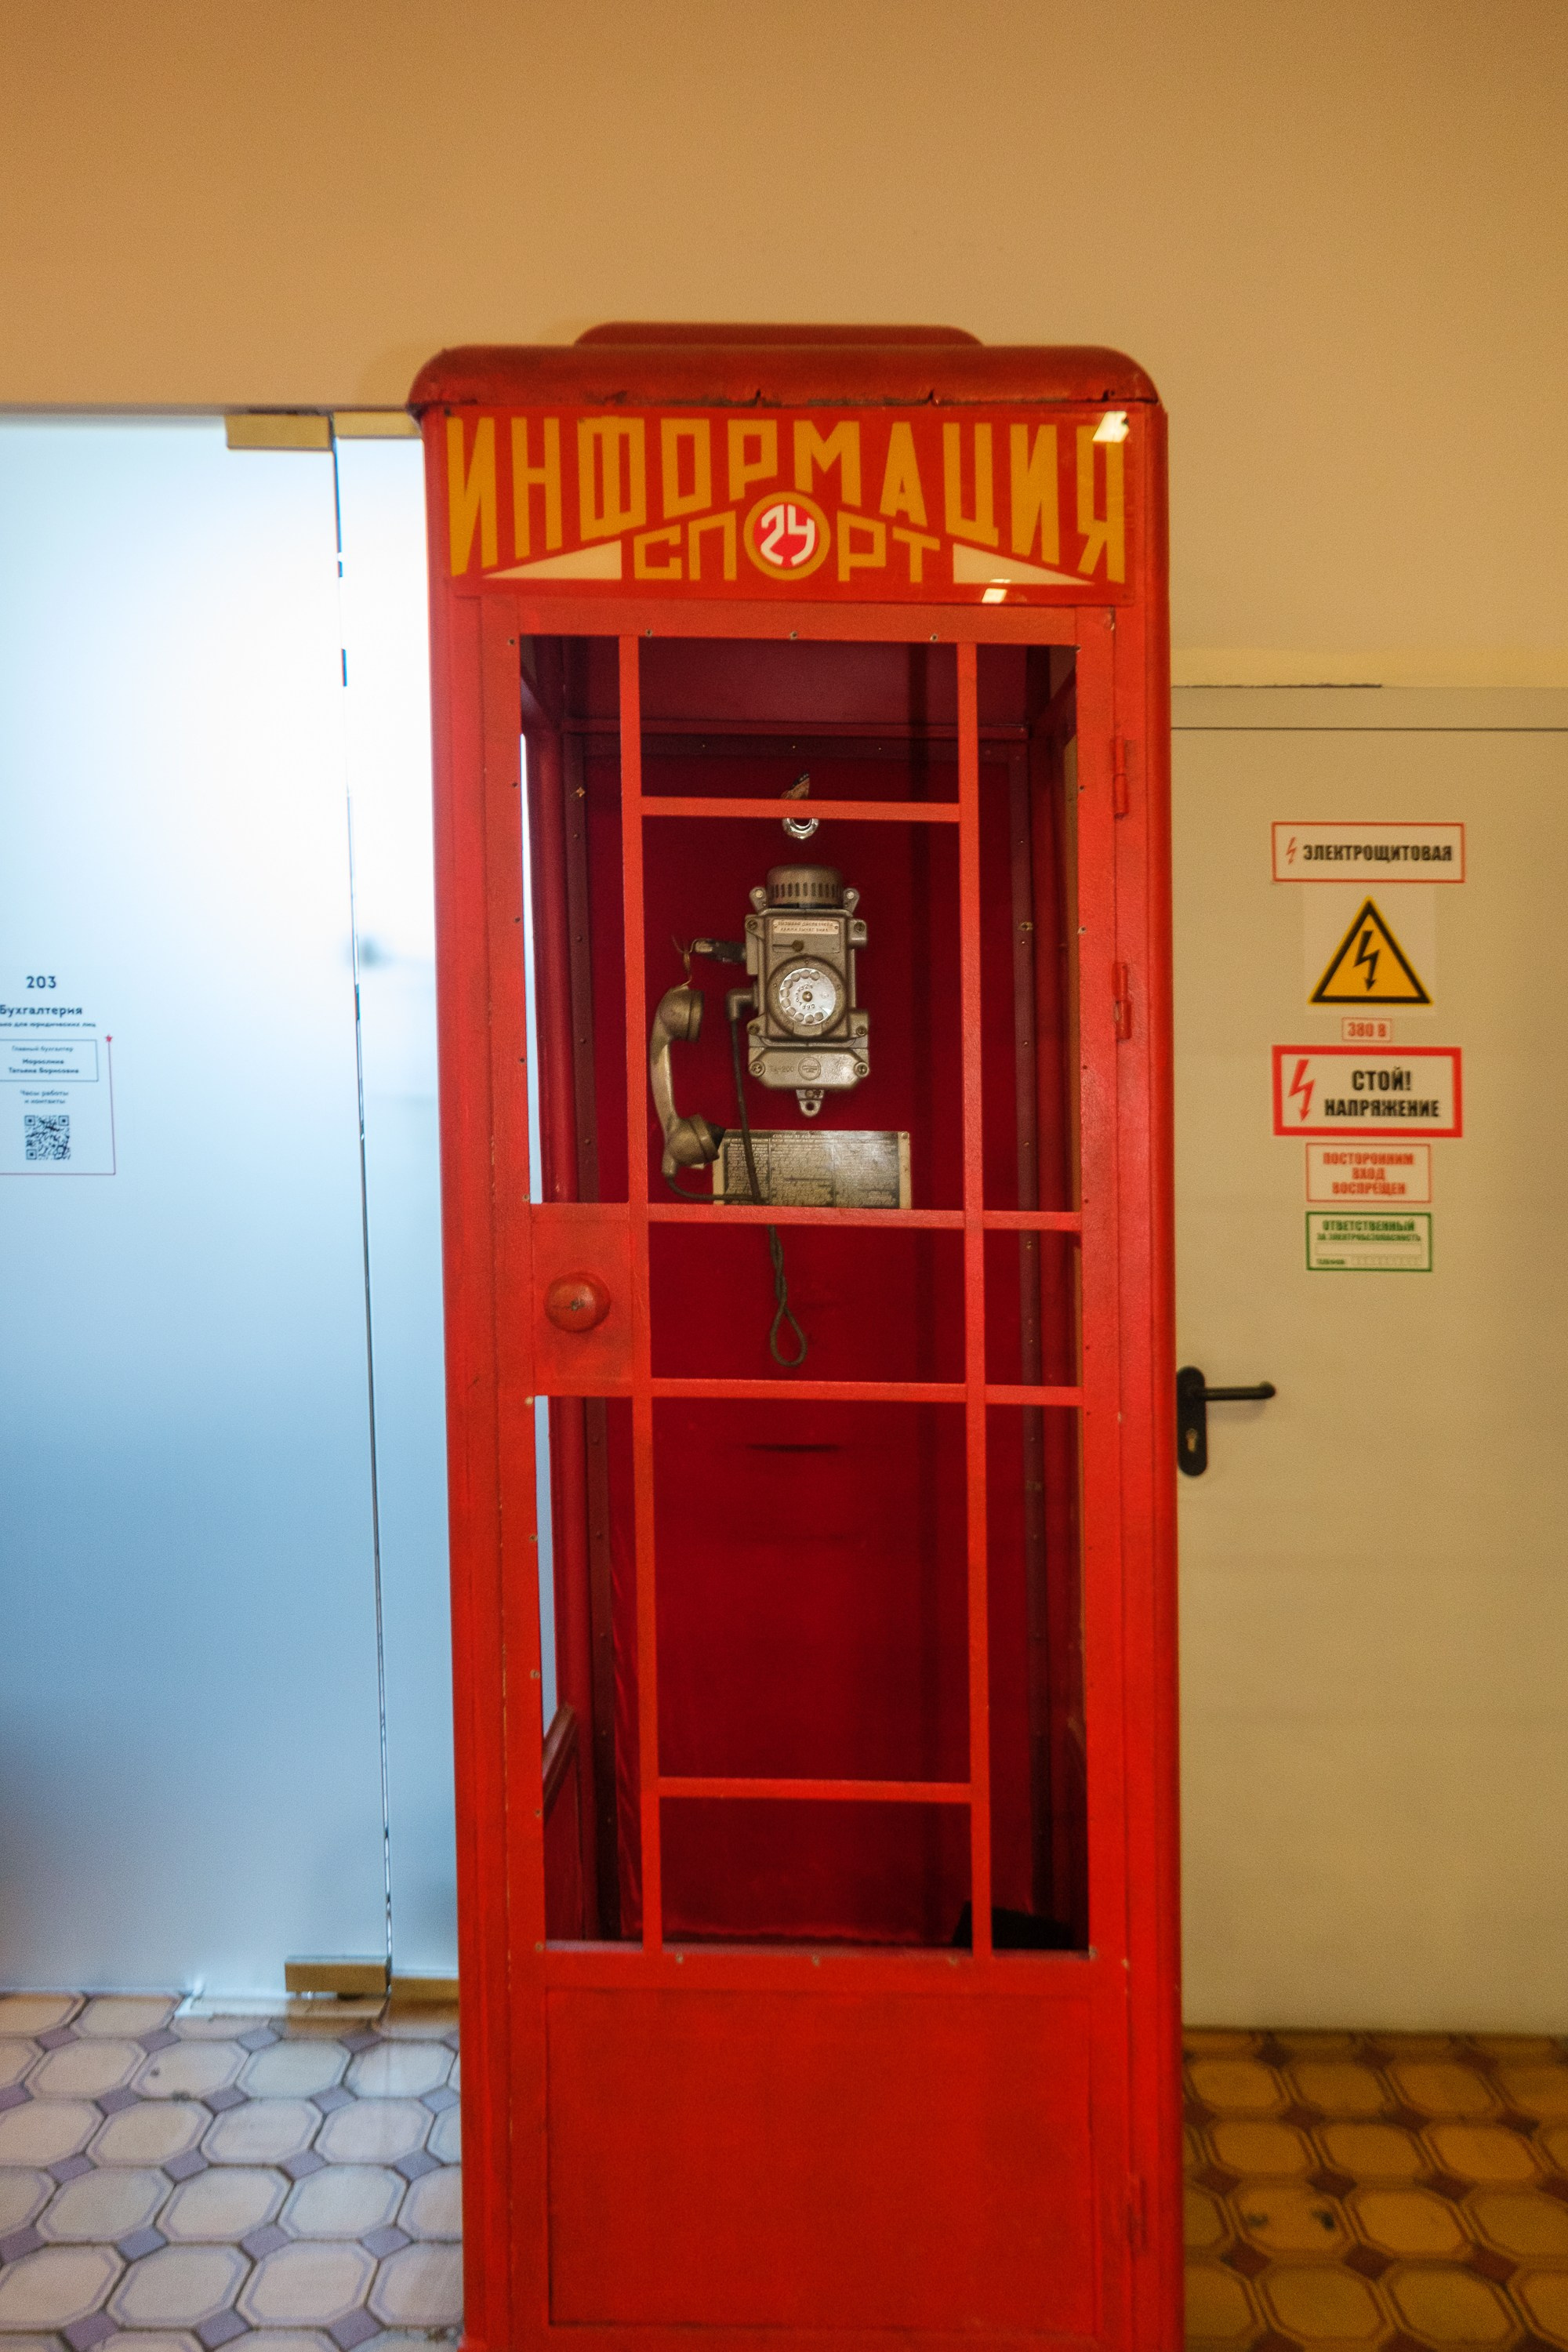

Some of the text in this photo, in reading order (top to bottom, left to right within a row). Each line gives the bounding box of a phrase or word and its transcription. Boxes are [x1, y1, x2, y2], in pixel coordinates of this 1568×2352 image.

[445, 415, 1127, 585] ИНФОРМАЦИЯ
[760, 503, 815, 566] 24
[1302, 844, 1453, 863] ЭЛЕКТРОЩИТОВАЯ
[26, 975, 57, 989] 203
[0, 1004, 82, 1018] Бухгалтерия
[1347, 1022, 1375, 1037] 380
[1351, 1066, 1412, 1092] СТОЙ!
[1324, 1099, 1440, 1119] НАПРЯЖЕНИЕ
[1323, 1152, 1414, 1165] ПОСТОРОННИМ
[1352, 1167, 1385, 1181] ВХОД
[1332, 1181, 1406, 1195] ВОСПРЕЩЕН
[1322, 1218, 1415, 1232] ОТВЕТСТВЕННЫЙ
